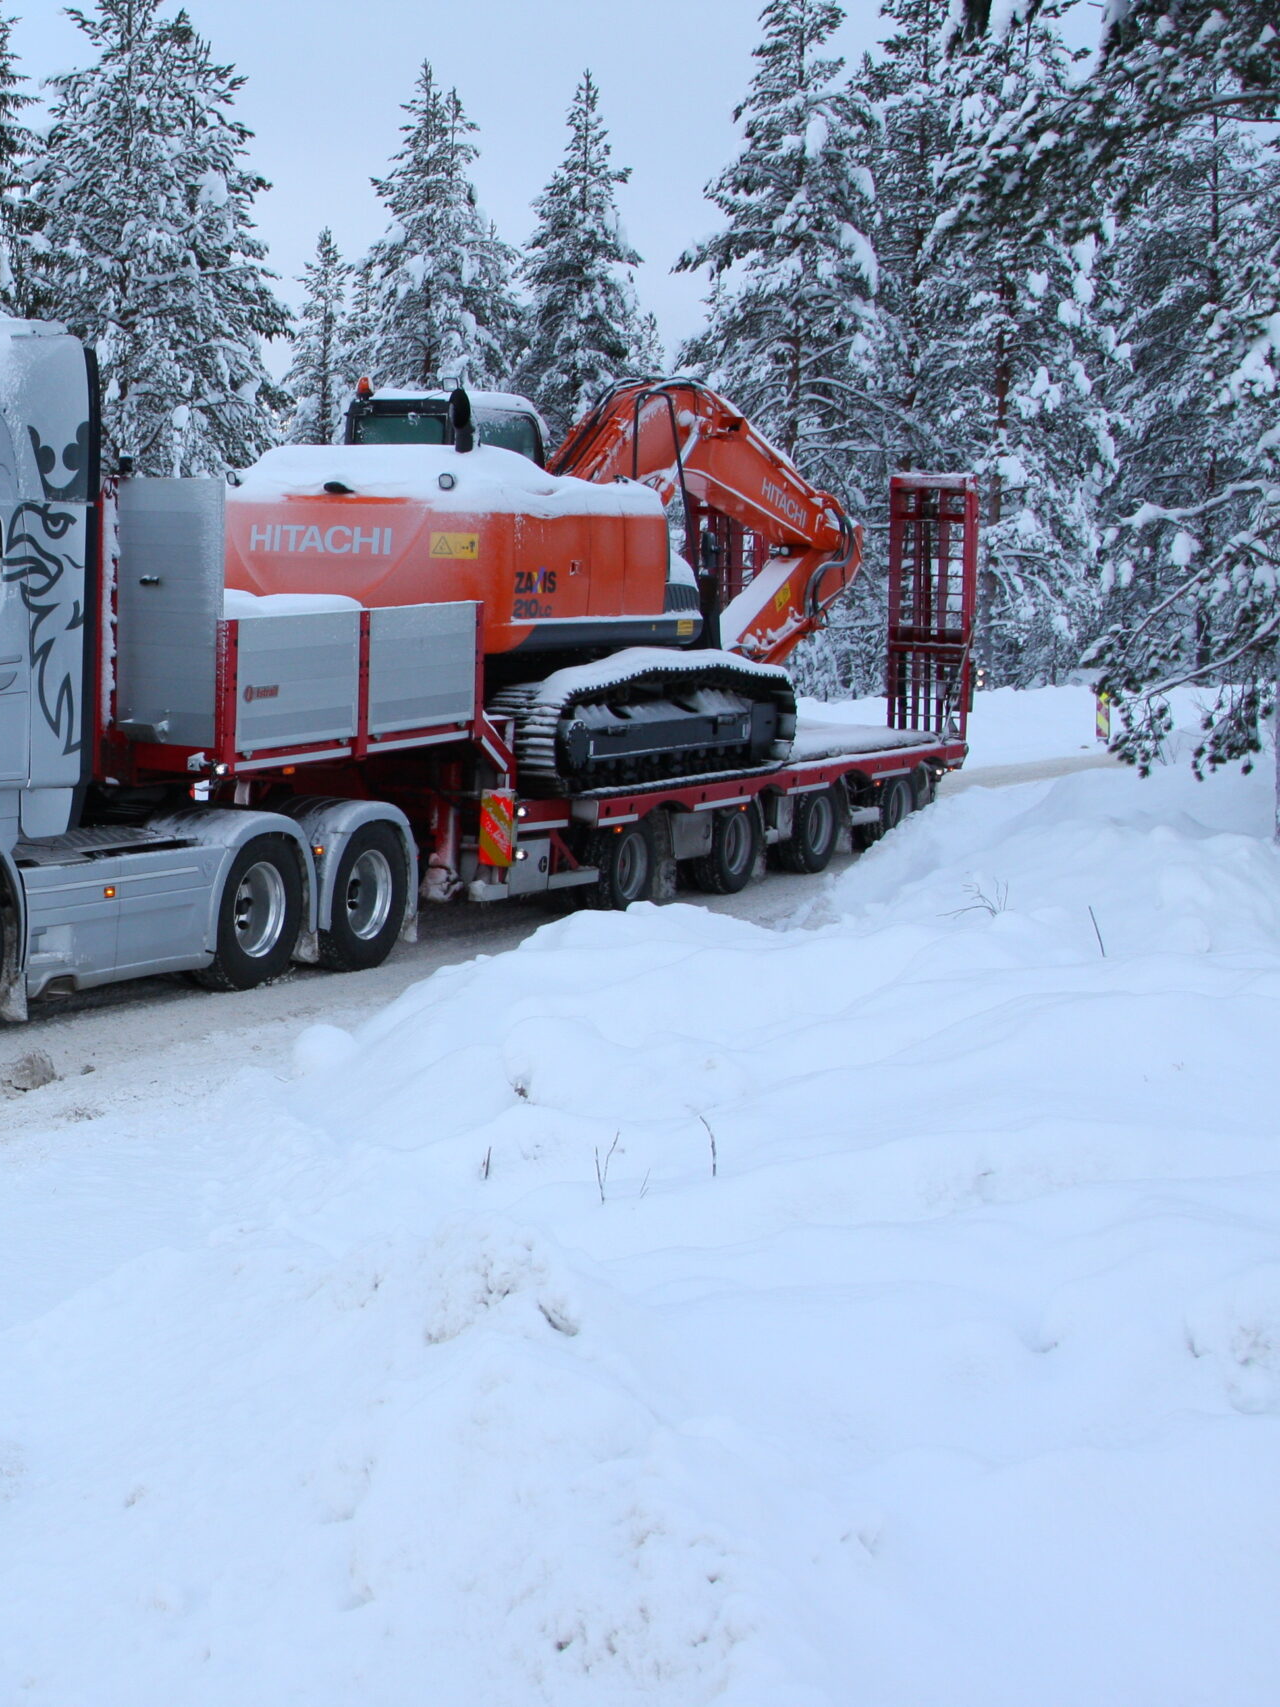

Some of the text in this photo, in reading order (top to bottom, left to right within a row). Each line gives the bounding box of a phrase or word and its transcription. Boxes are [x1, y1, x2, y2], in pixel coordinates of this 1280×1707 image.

[761, 476, 807, 529] HITACHI
[249, 524, 392, 555] HITACHI
[514, 567, 557, 594] ZAXIS
